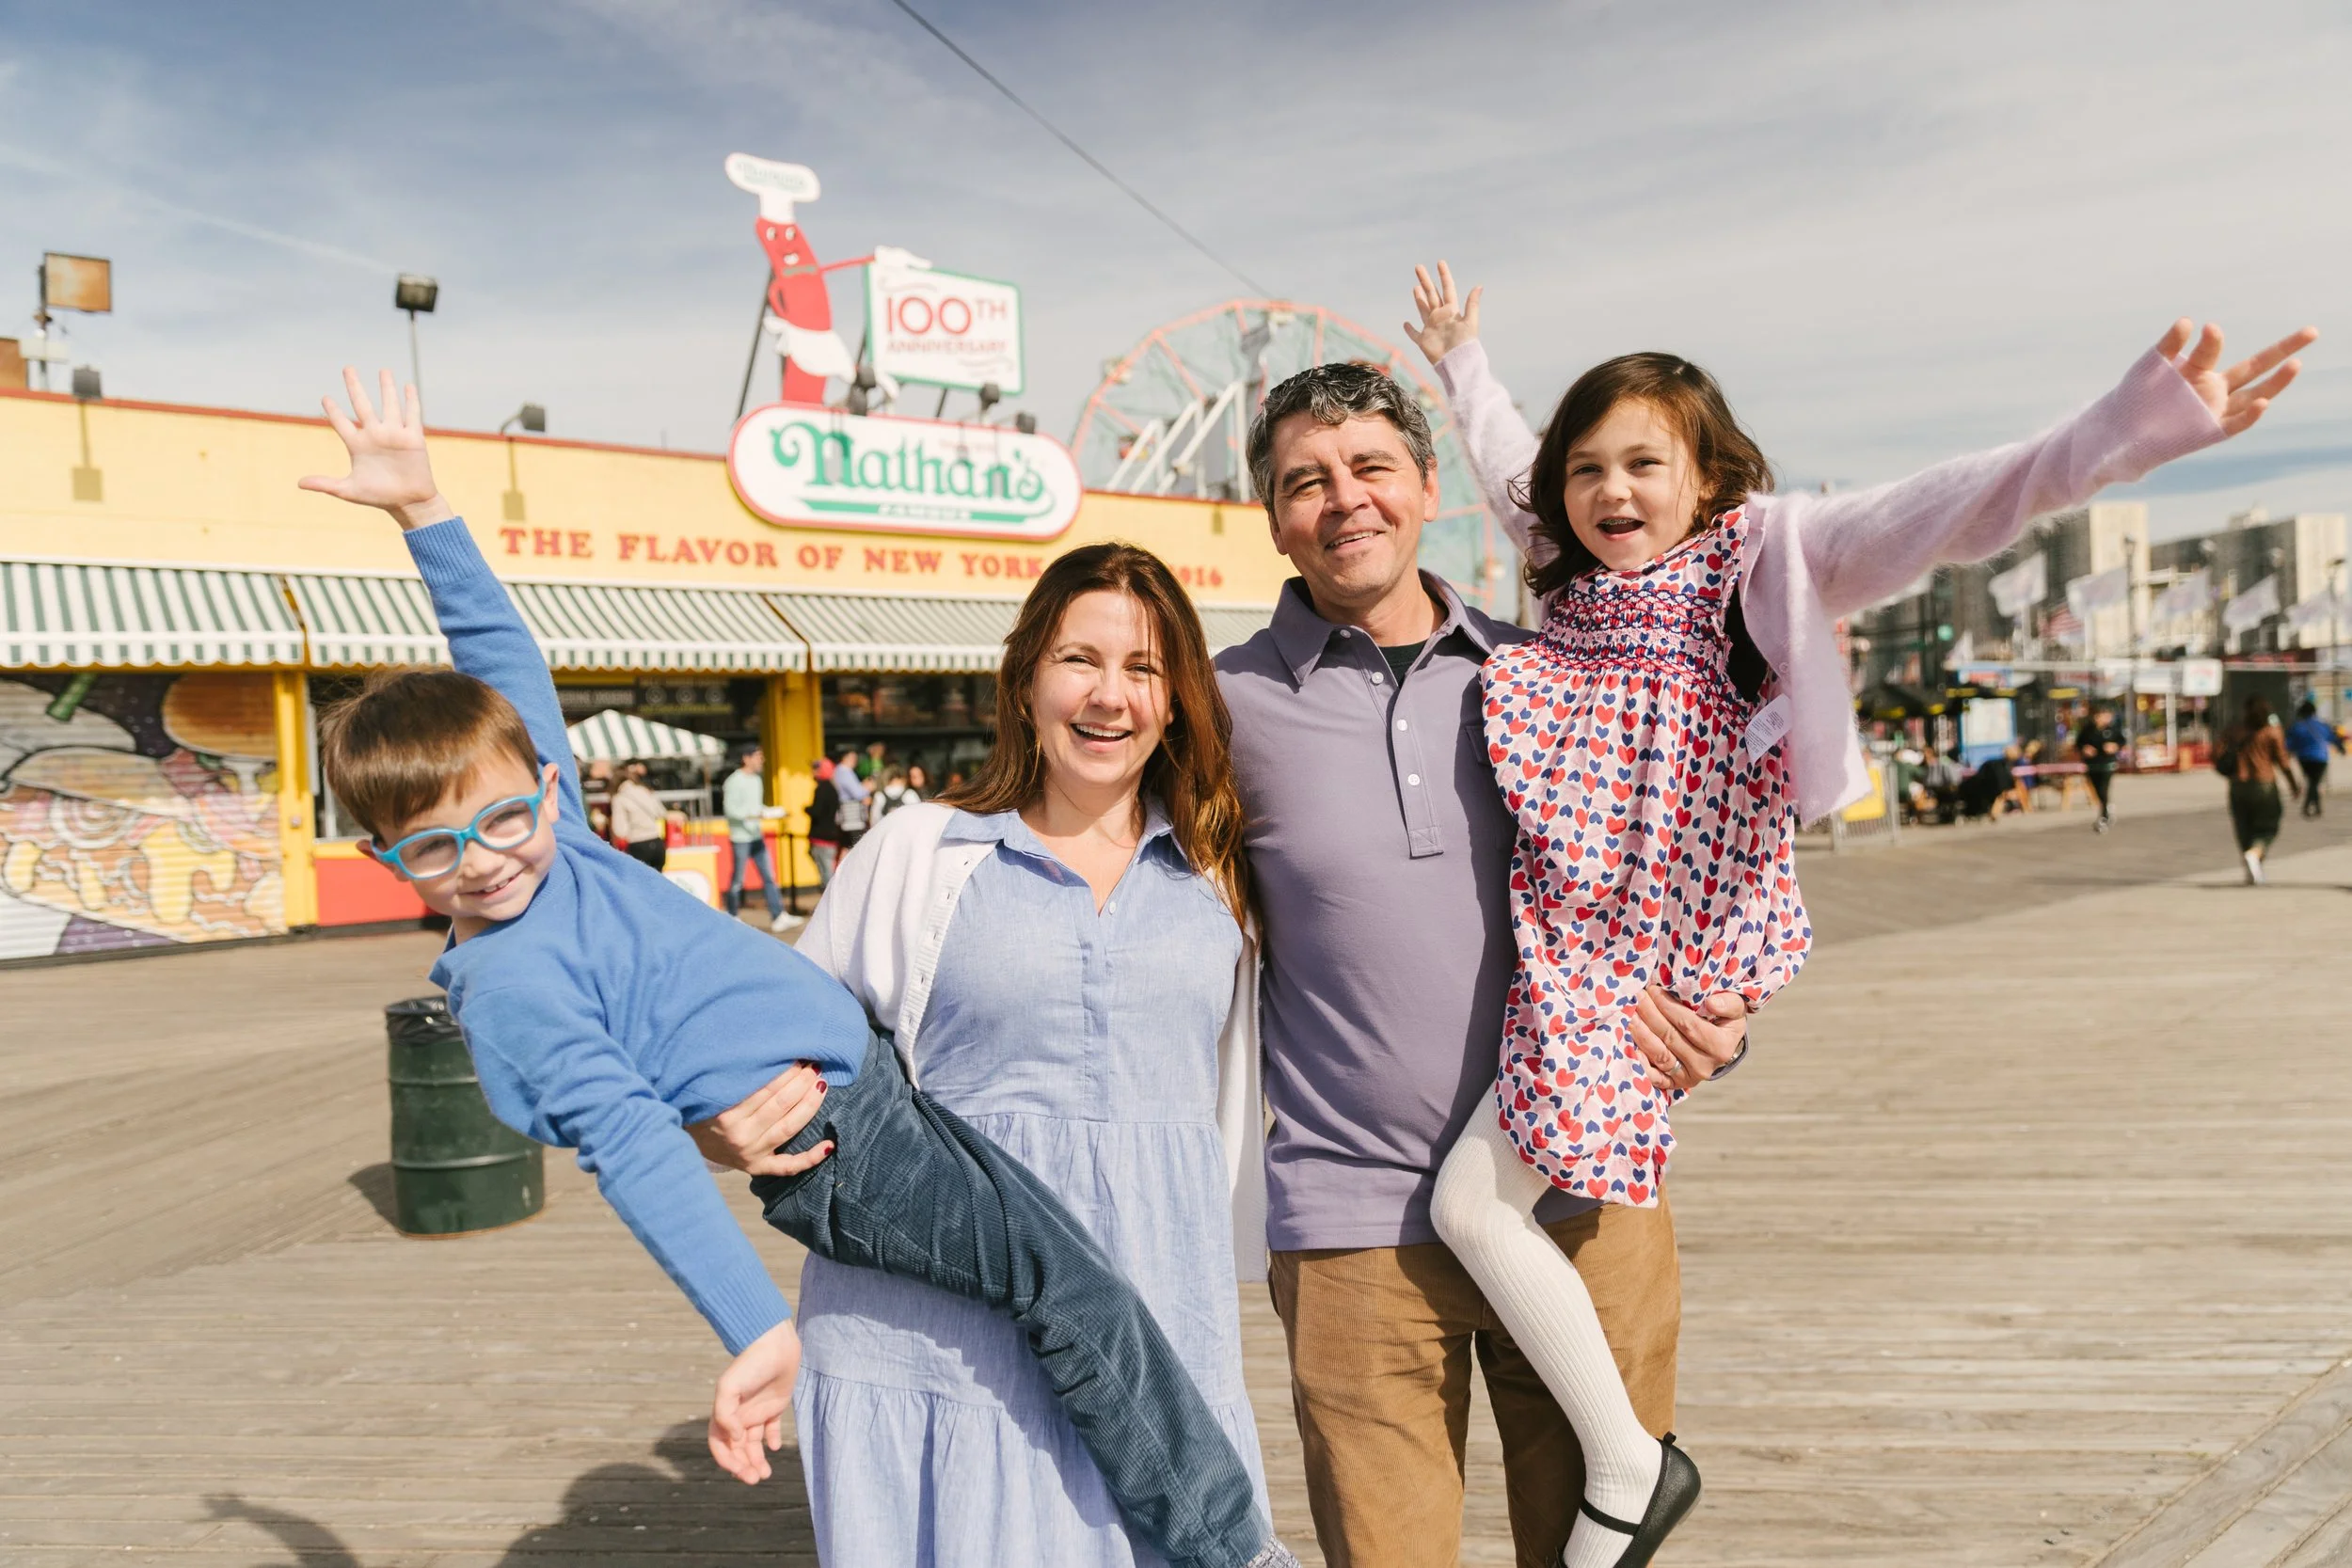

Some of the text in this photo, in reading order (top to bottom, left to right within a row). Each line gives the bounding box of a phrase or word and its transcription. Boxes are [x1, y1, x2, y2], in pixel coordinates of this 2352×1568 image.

[886, 296, 1009, 336] 100TH
[887, 339, 1009, 355] ANNIVERSARY
[769, 421, 1047, 502] Nathan's
[500, 527, 1224, 588] THE FLAVOR OF NEW YORK 916
